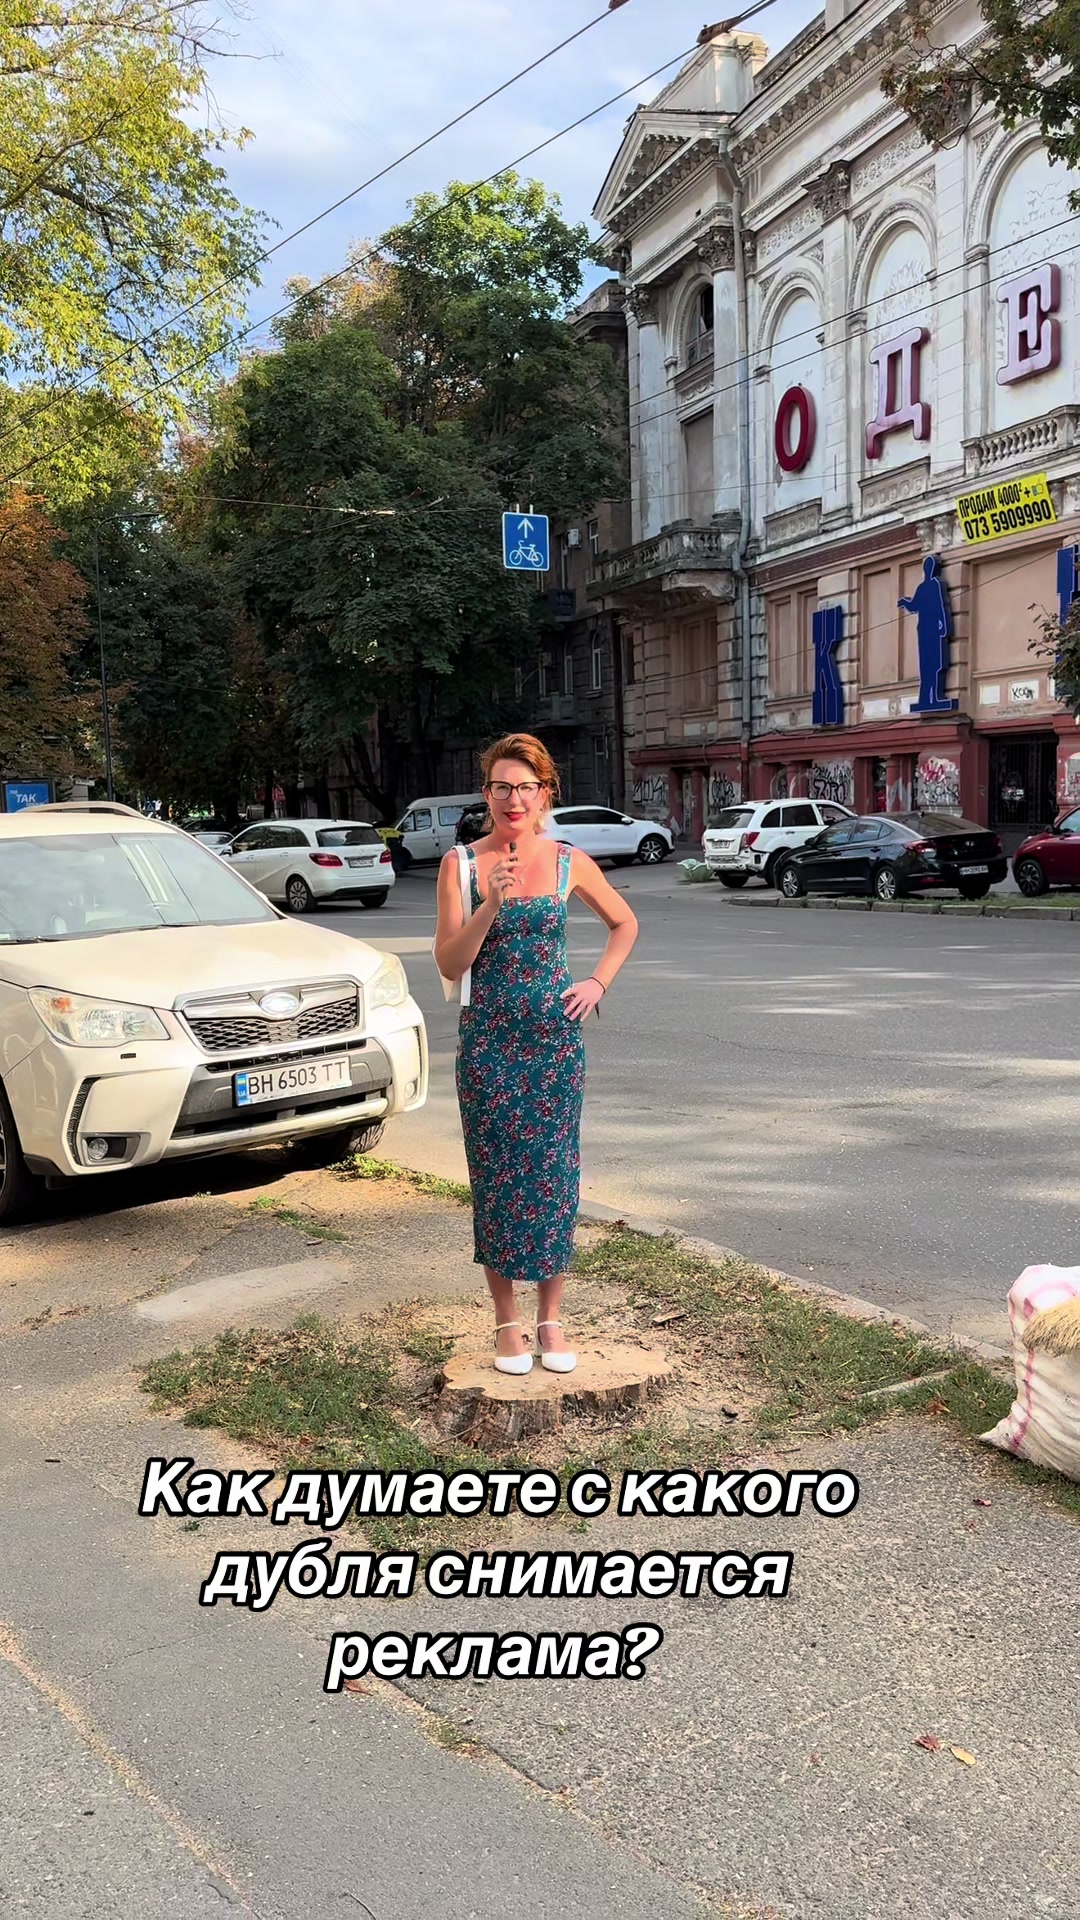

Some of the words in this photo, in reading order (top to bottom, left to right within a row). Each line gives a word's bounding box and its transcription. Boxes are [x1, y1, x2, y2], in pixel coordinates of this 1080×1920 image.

[958, 490, 998, 519] ПРОДАМ
[964, 515, 990, 540] 073
[991, 499, 1051, 533] 5909990
[248, 1073, 273, 1095] BH
[278, 1066, 317, 1090] 6503
[322, 1060, 346, 1082] TT
